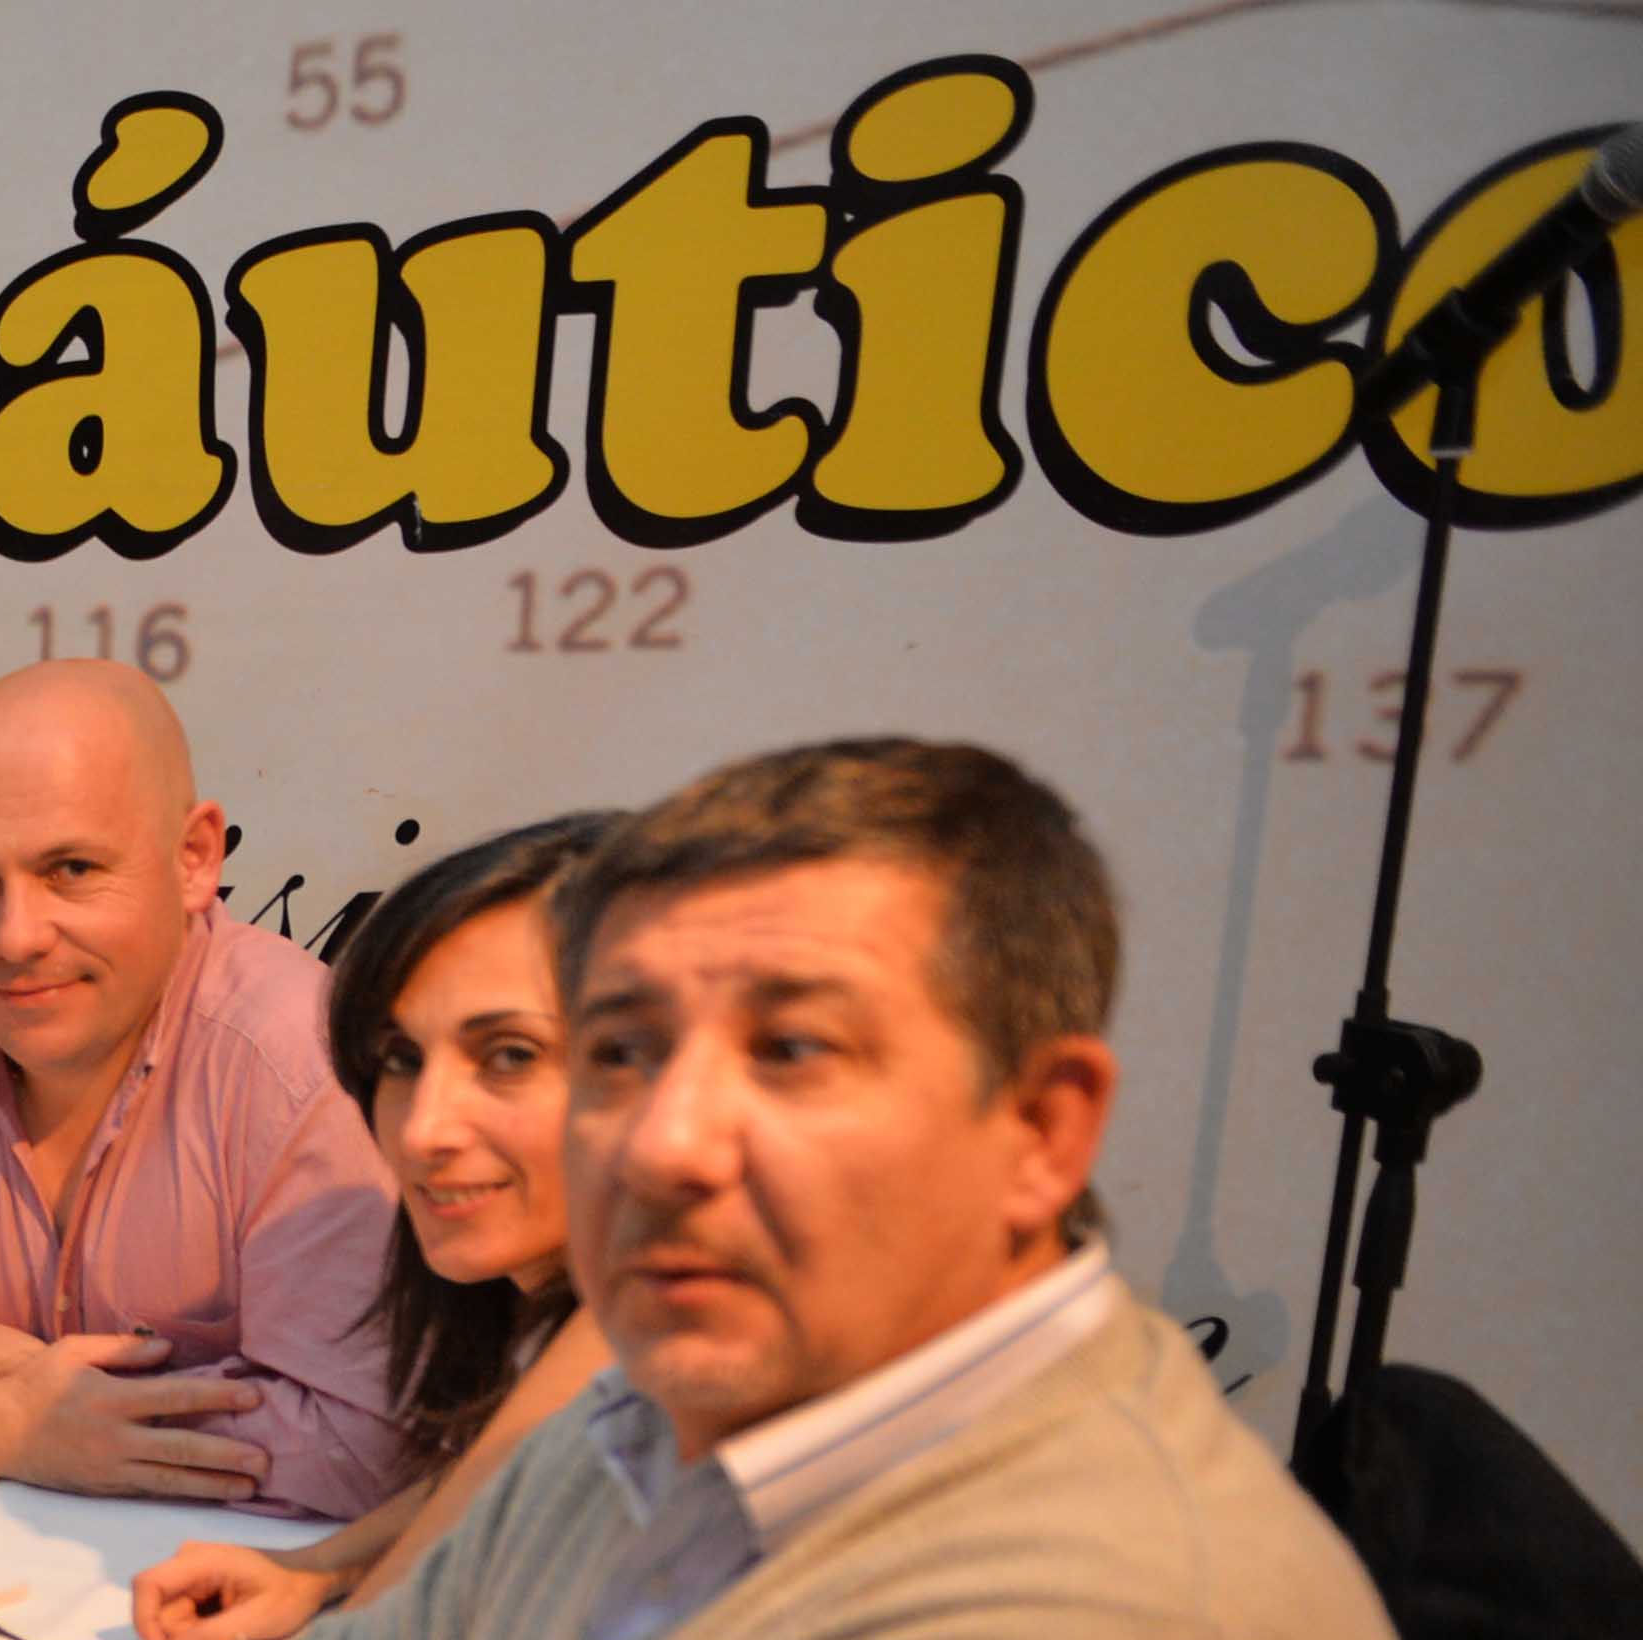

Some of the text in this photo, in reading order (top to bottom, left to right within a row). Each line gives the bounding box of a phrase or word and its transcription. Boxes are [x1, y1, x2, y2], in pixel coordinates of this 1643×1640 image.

[284, 34, 407, 132] 55
[27, 602, 190, 684] 116
[503, 565, 692, 654] 122
[1282, 668, 1524, 763] 137
